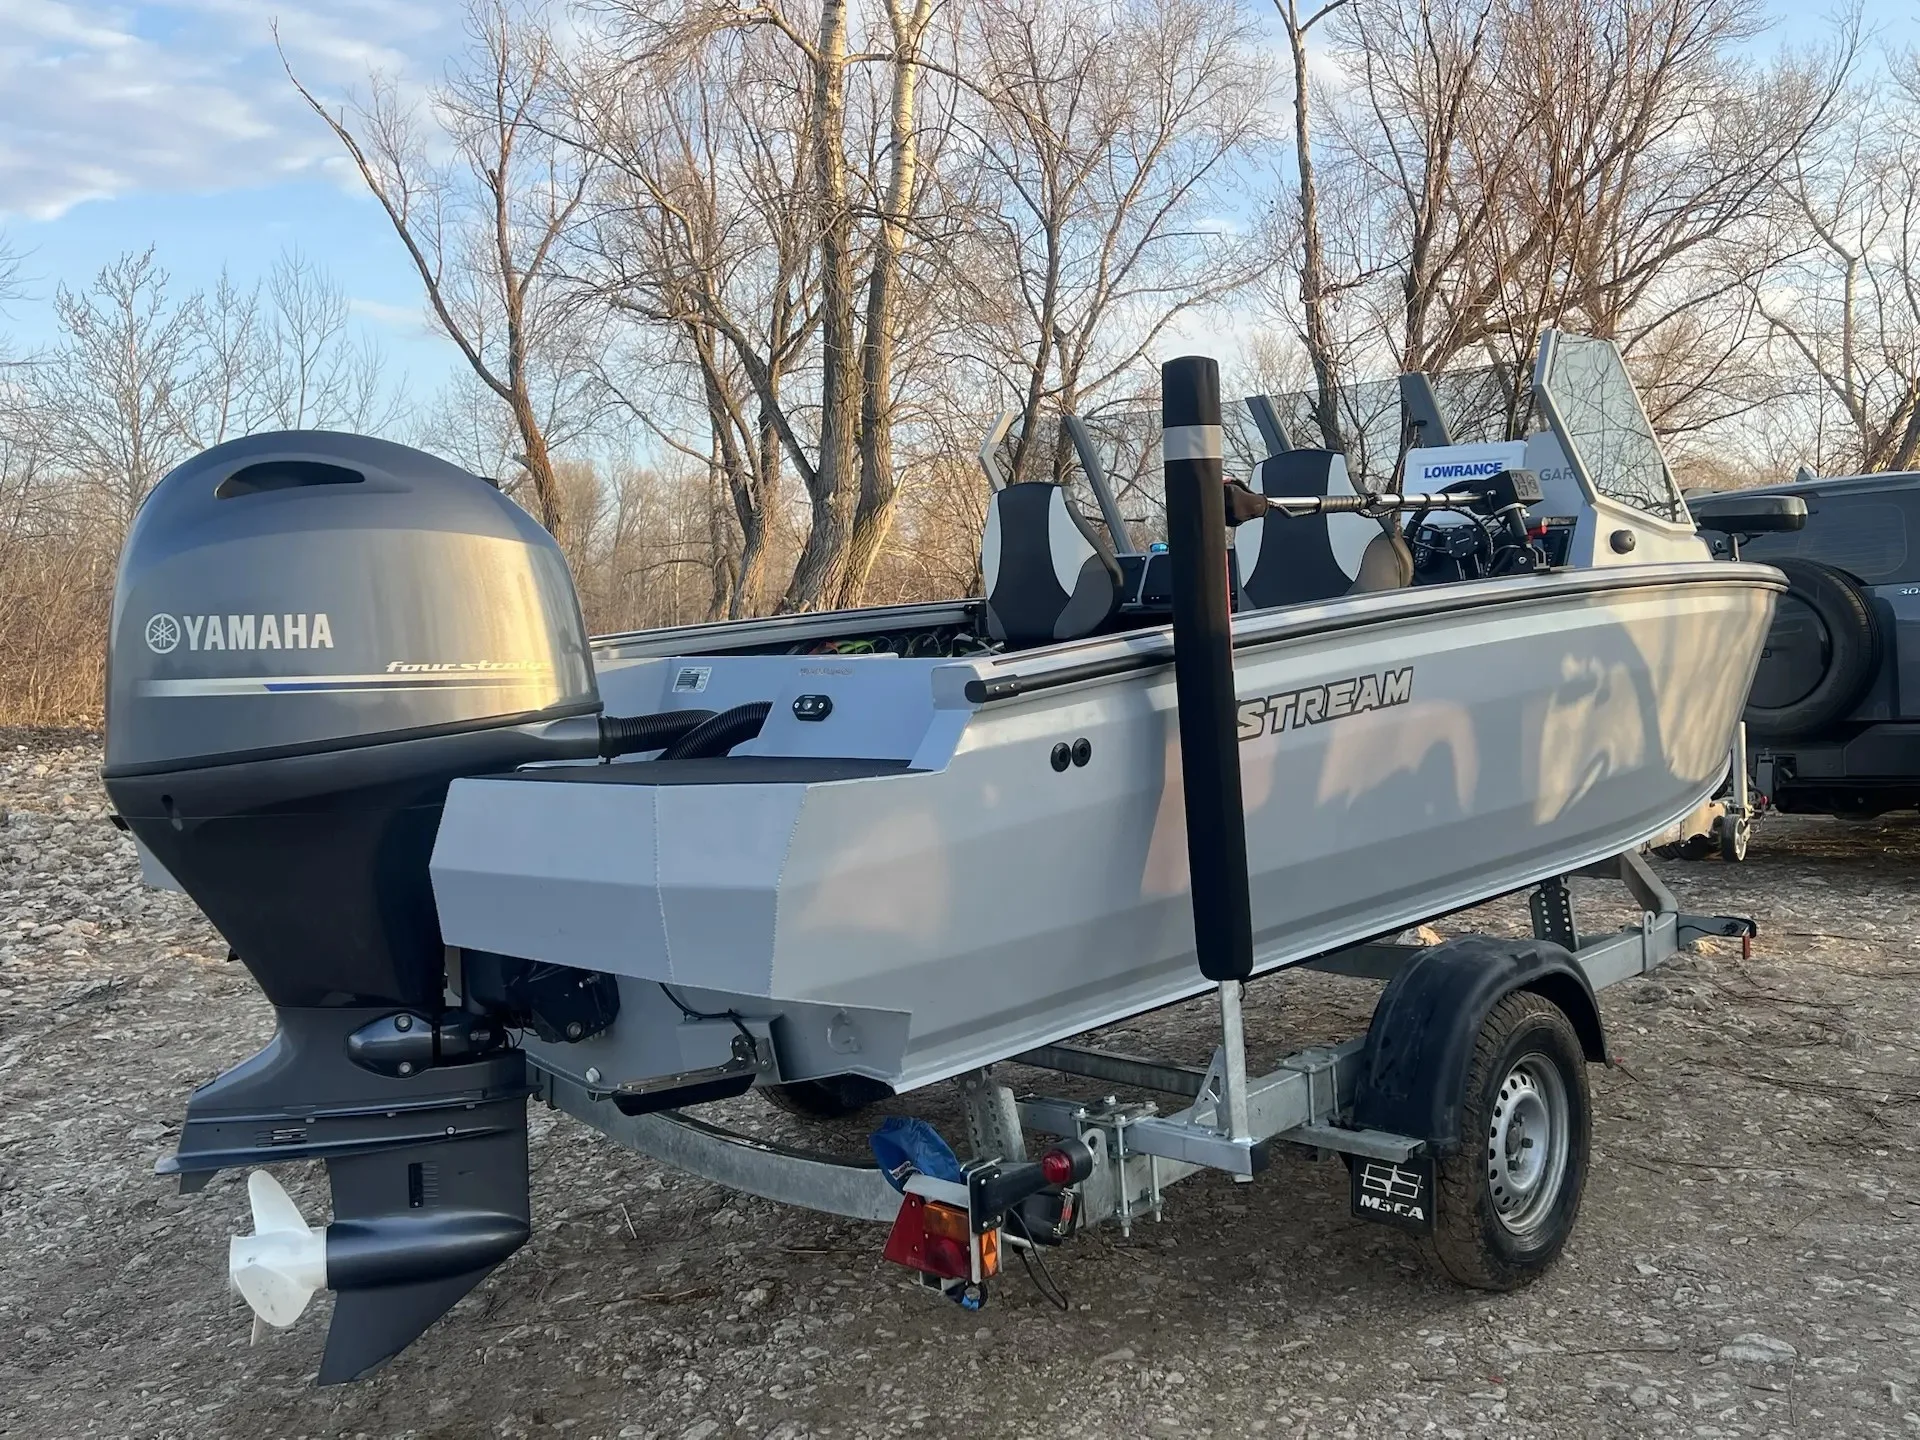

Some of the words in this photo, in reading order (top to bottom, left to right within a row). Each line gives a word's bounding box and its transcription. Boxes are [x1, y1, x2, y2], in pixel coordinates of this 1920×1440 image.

[1424, 462, 1503, 479] LOWRANCE
[183, 613, 334, 650] YAMAHA
[1236, 666, 1414, 742] STREAM
